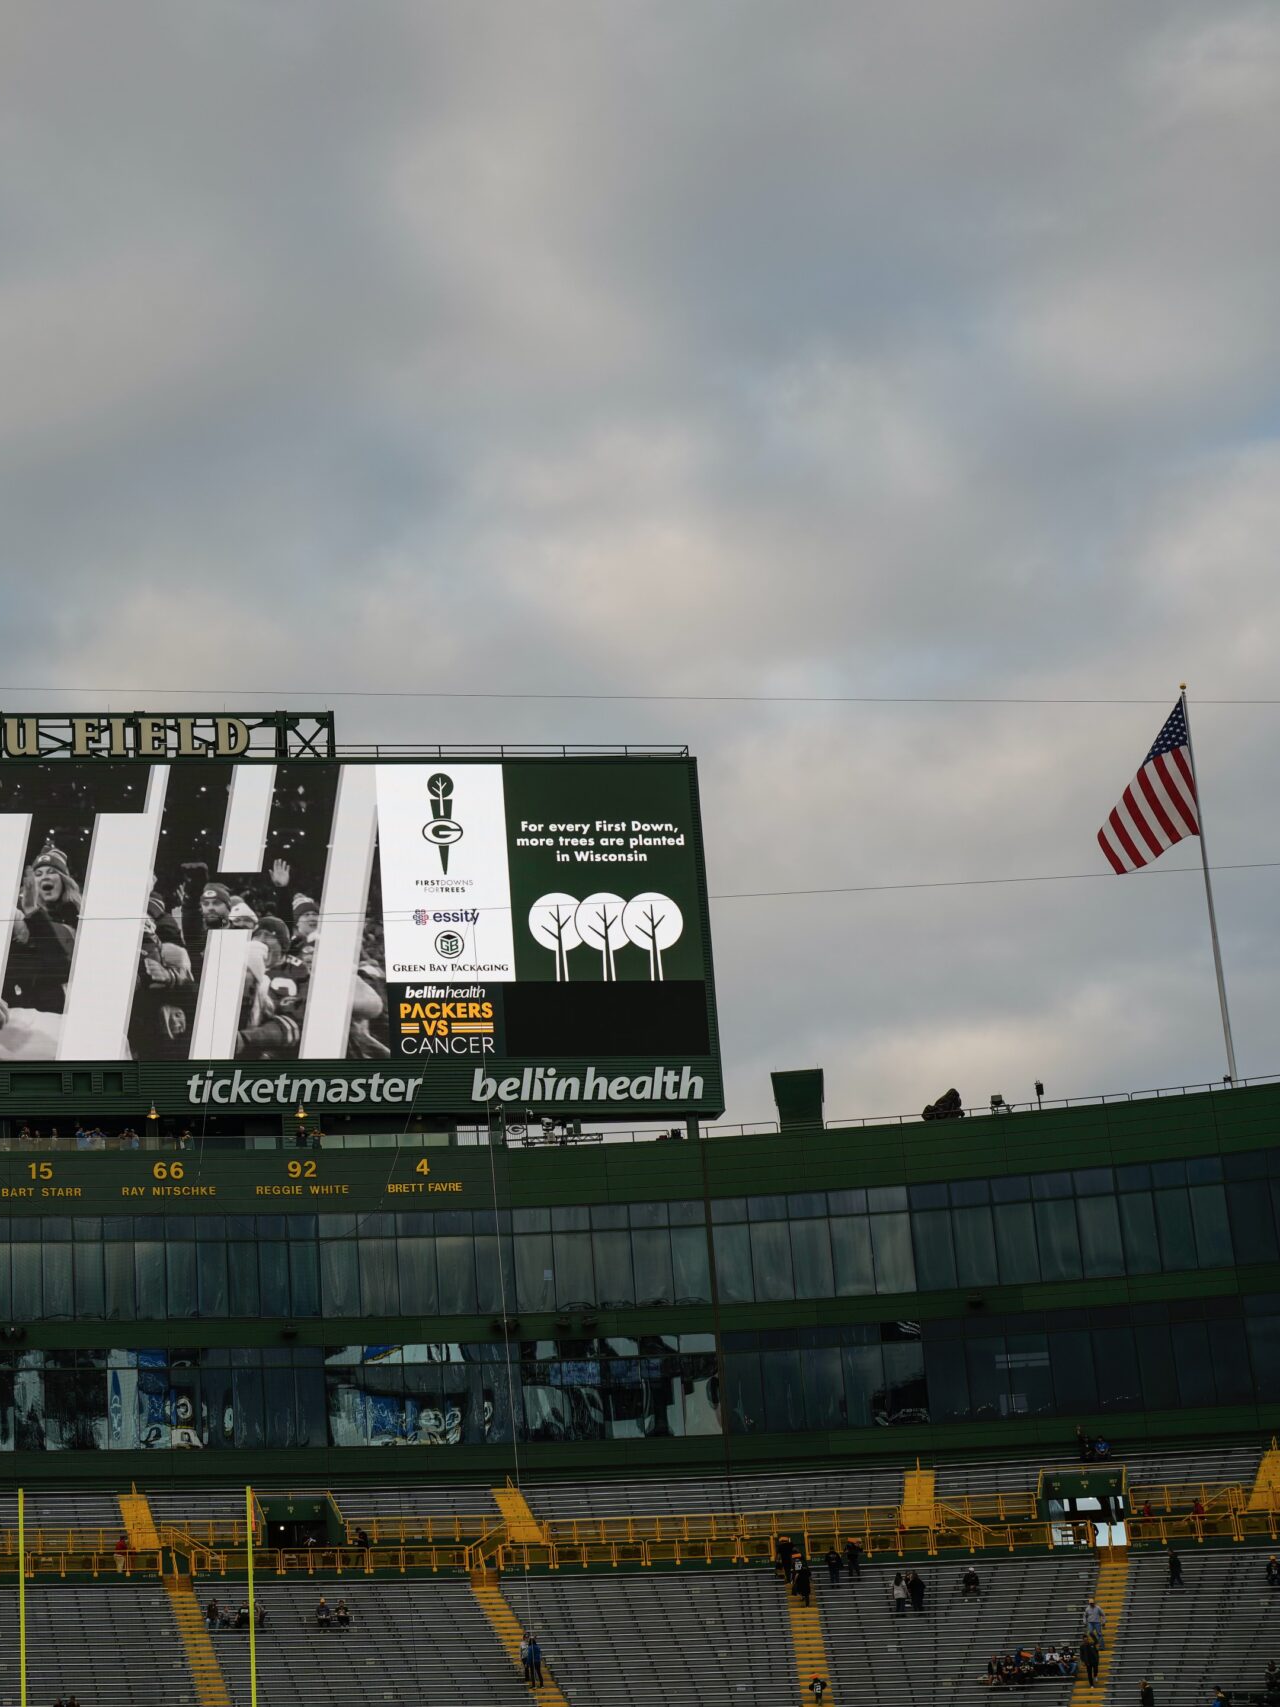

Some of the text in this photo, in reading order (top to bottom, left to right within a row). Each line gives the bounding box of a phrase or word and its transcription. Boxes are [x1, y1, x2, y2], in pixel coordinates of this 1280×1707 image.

[72, 717, 251, 758] FIELD
[521, 820, 678, 834] For every First Down,
[516, 834, 685, 849] more trees are planted
[556, 850, 648, 862] in Wisconsin
[433, 909, 480, 925] essity
[393, 963, 509, 972] GREEN BAY PACKAGING
[400, 1002, 493, 1019] PACKERS
[422, 1020, 449, 1036] VS
[400, 1036, 495, 1054] CANCER
[187, 1069, 423, 1106] ticketmaster
[27, 1162, 53, 1180] 15
[152, 1161, 184, 1180] 66
[287, 1160, 317, 1179] 92
[415, 1158, 430, 1176] 4
[1, 1187, 82, 1198] BART STARR
[121, 1186, 216, 1197] RAY NITSCHKE
[256, 1184, 349, 1196] REGGIE WHITE
[387, 1182, 463, 1194] BRETT FAVRE
